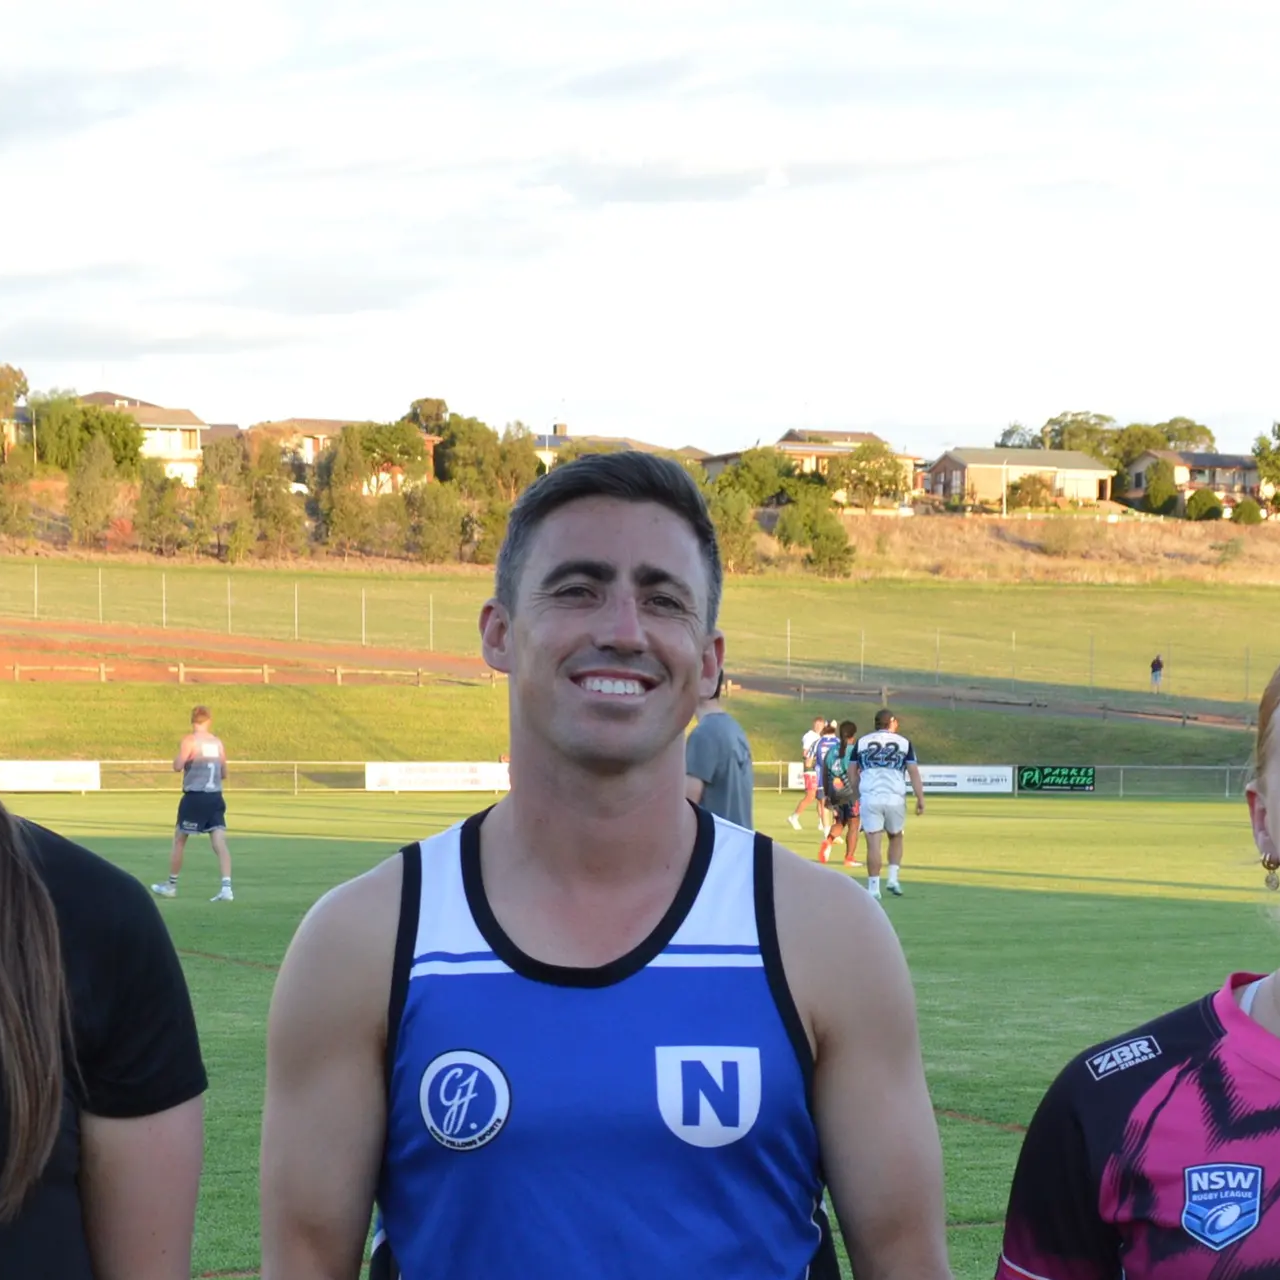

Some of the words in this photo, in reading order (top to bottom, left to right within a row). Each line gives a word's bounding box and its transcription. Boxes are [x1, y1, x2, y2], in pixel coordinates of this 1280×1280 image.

[867, 741, 899, 762] 22
[1044, 767, 1094, 776] PARKES
[1093, 1040, 1153, 1074] ZBR
[680, 1060, 740, 1129] N
[1191, 1170, 1256, 1191] NSW
[1220, 1190, 1253, 1199] LEAGUE
